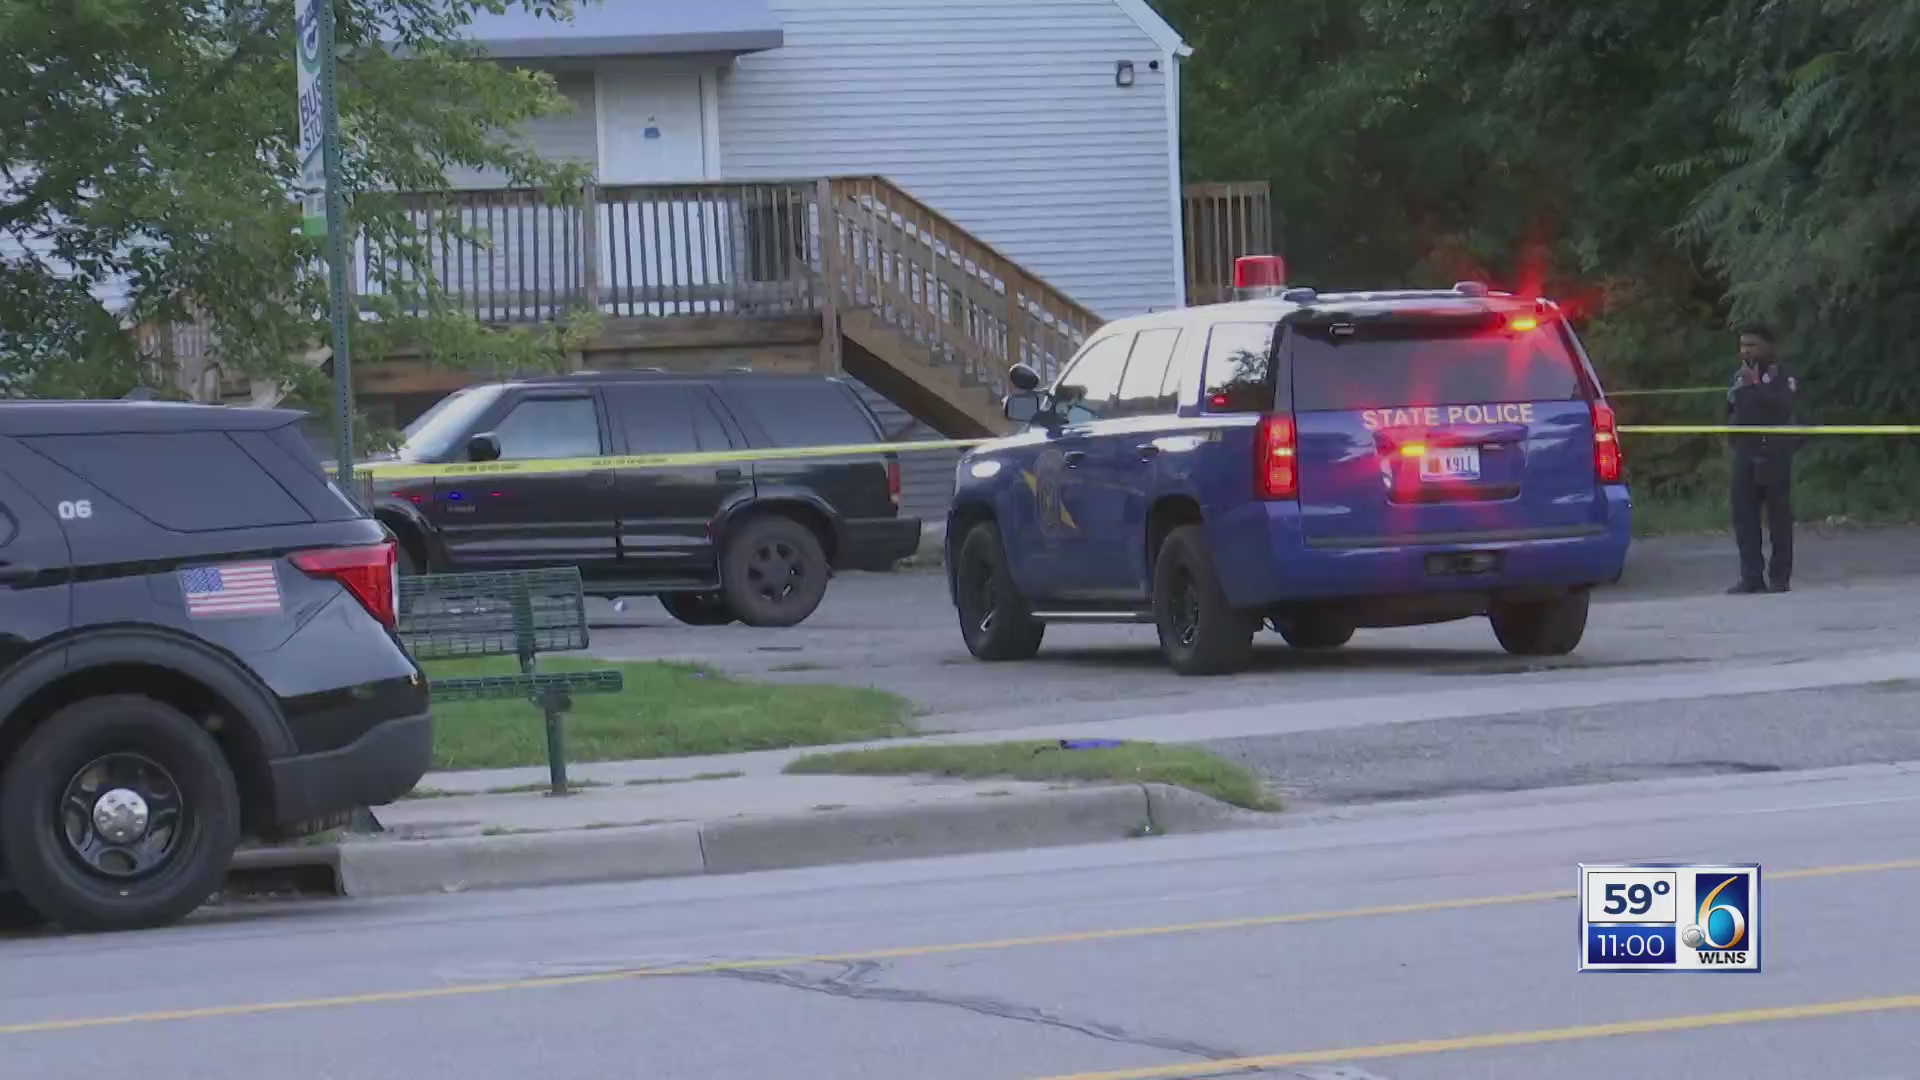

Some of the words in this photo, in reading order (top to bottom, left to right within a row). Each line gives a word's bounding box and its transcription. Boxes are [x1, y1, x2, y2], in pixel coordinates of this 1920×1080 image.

[304, 115, 322, 151] STO
[1362, 408, 1440, 430] STATE
[1448, 403, 1536, 426] POLICE
[58, 500, 92, 519] 06
